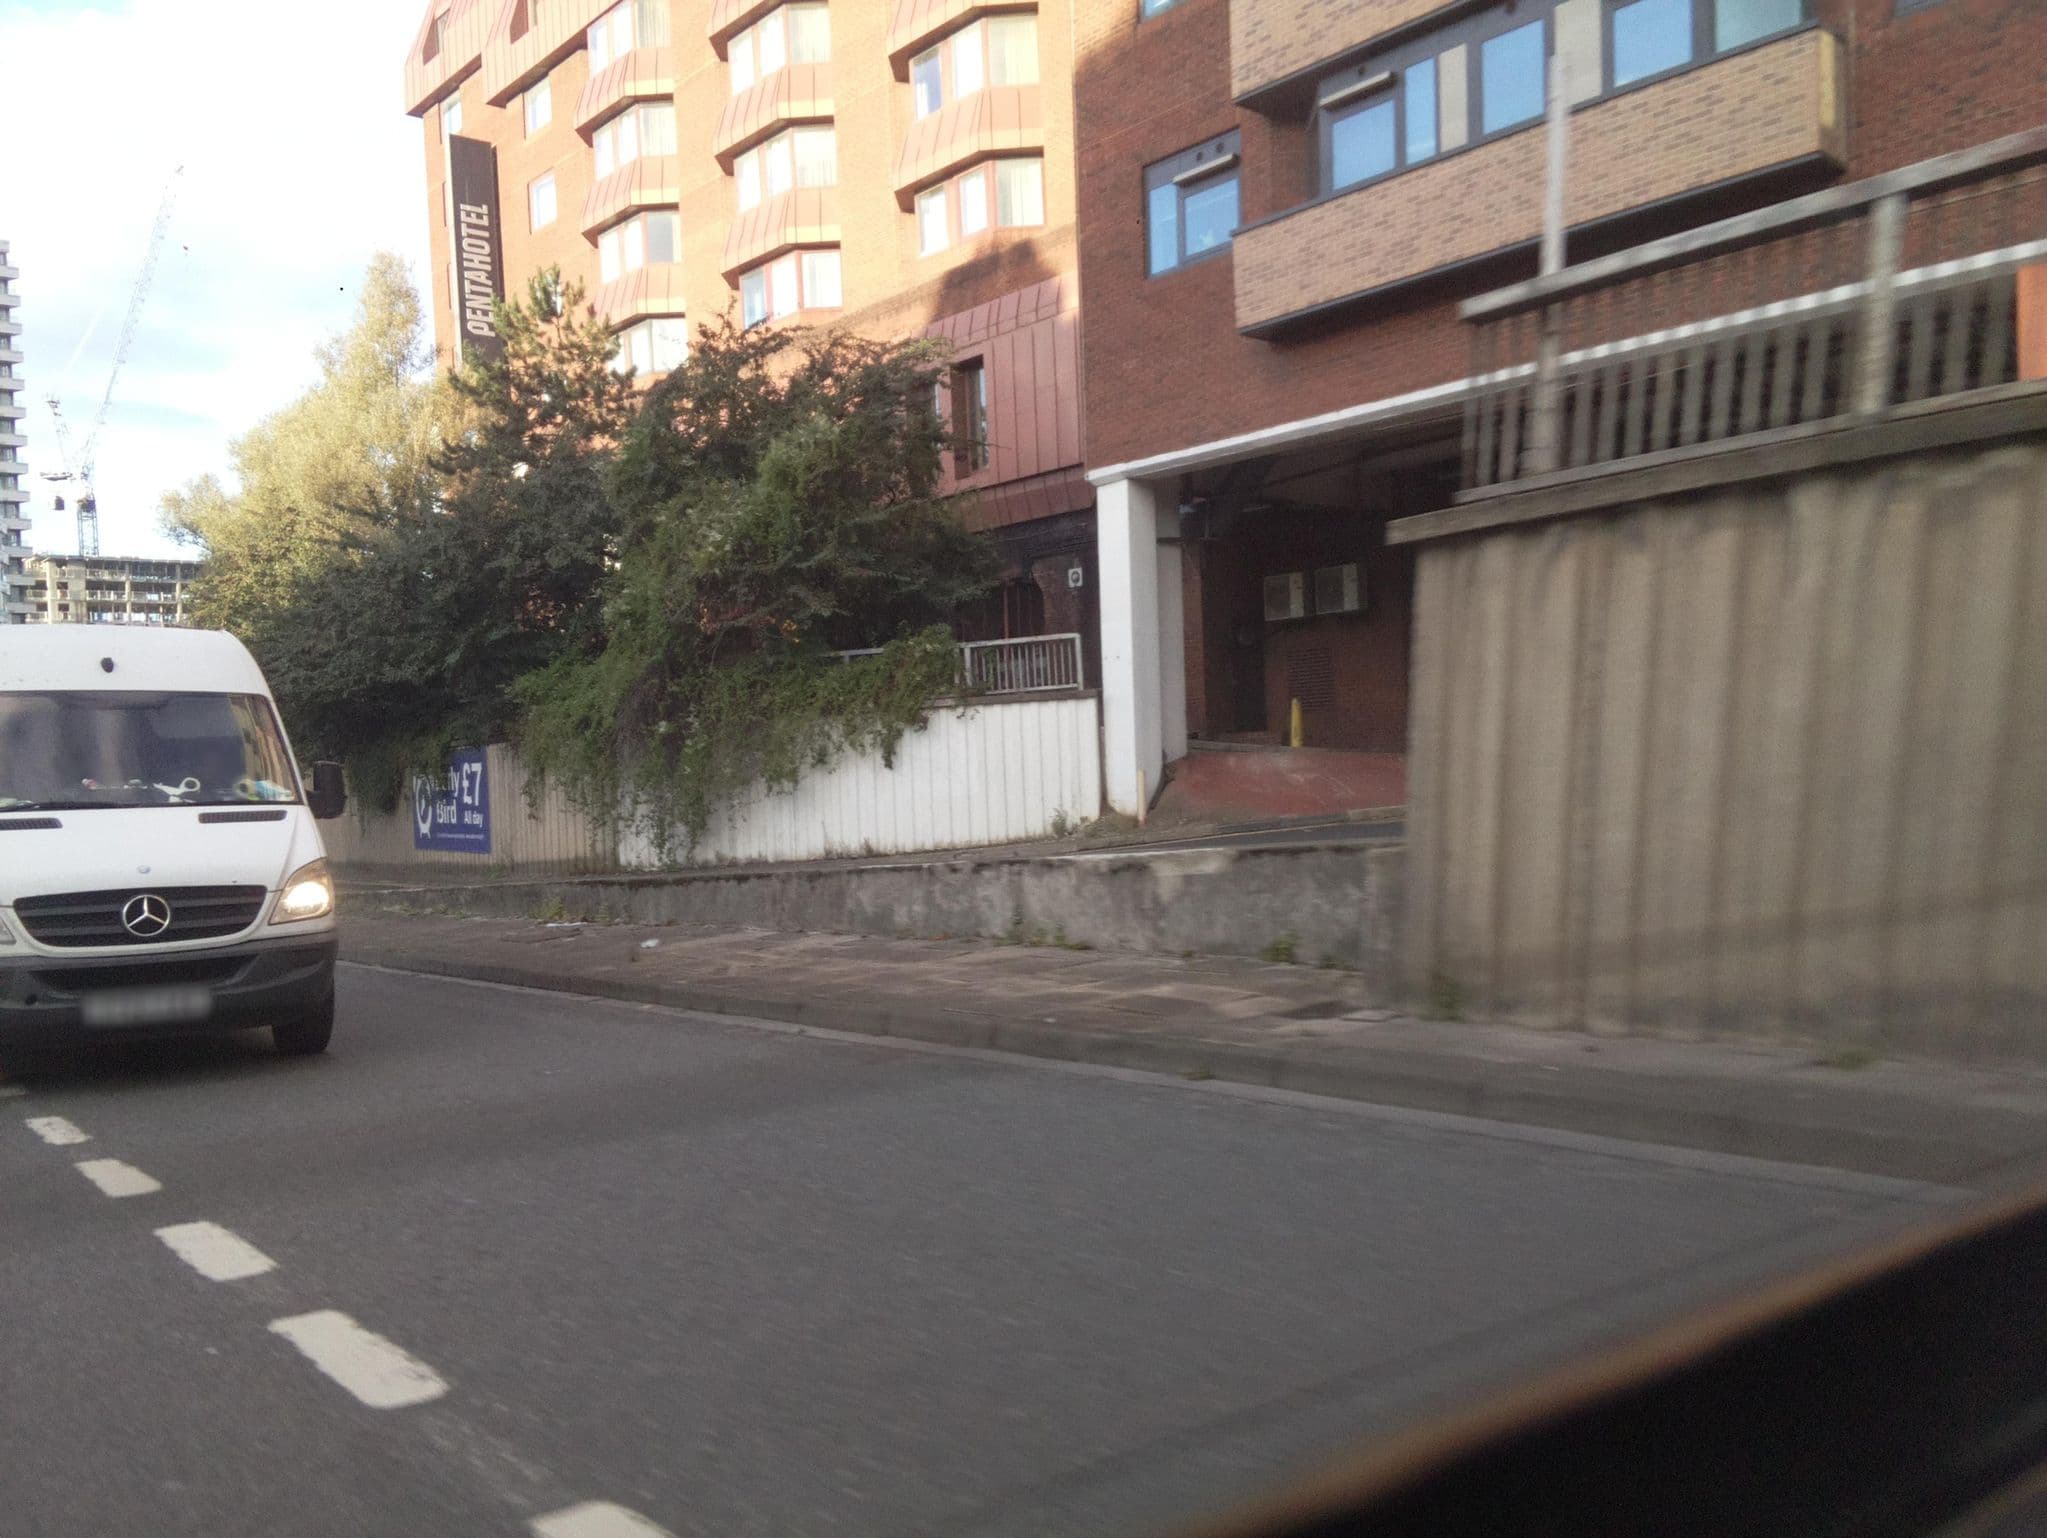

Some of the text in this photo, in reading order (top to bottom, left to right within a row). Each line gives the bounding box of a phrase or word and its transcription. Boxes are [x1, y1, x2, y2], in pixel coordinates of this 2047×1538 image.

[460, 203, 496, 338] PENTAHOTEL
[462, 761, 482, 806] £7
[436, 799, 457, 824] Bird
